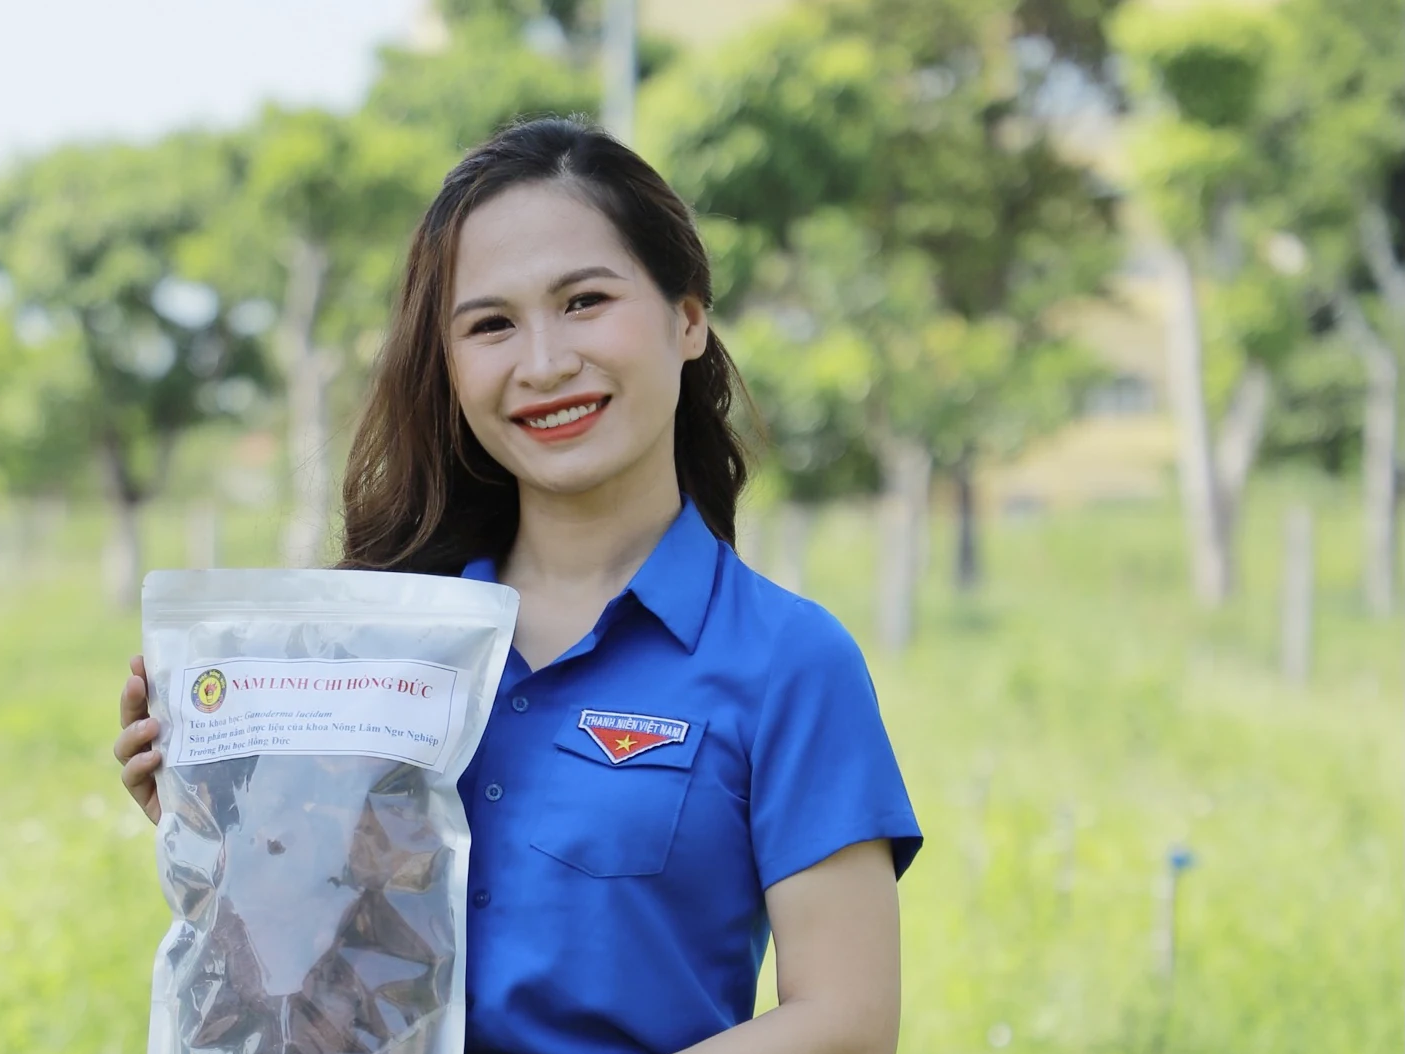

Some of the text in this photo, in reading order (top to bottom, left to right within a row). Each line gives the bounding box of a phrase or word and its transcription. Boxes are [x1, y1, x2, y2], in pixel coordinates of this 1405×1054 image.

[269, 677, 309, 690] LINH
[313, 678, 342, 691] CHI
[397, 678, 434, 699] ĐỨC
[209, 717, 227, 728] khoa
[244, 710, 294, 720] Ganoderma
[296, 710, 332, 718] lucidum
[586, 715, 681, 738] THANH NIÊN VIỆT NAM
[232, 740, 246, 750] học
[272, 736, 291, 745] Đức
[306, 722, 328, 731] khoa
[332, 722, 356, 732] Nông
[358, 722, 381, 732] Lâm
[407, 730, 440, 747] Nghiệp
